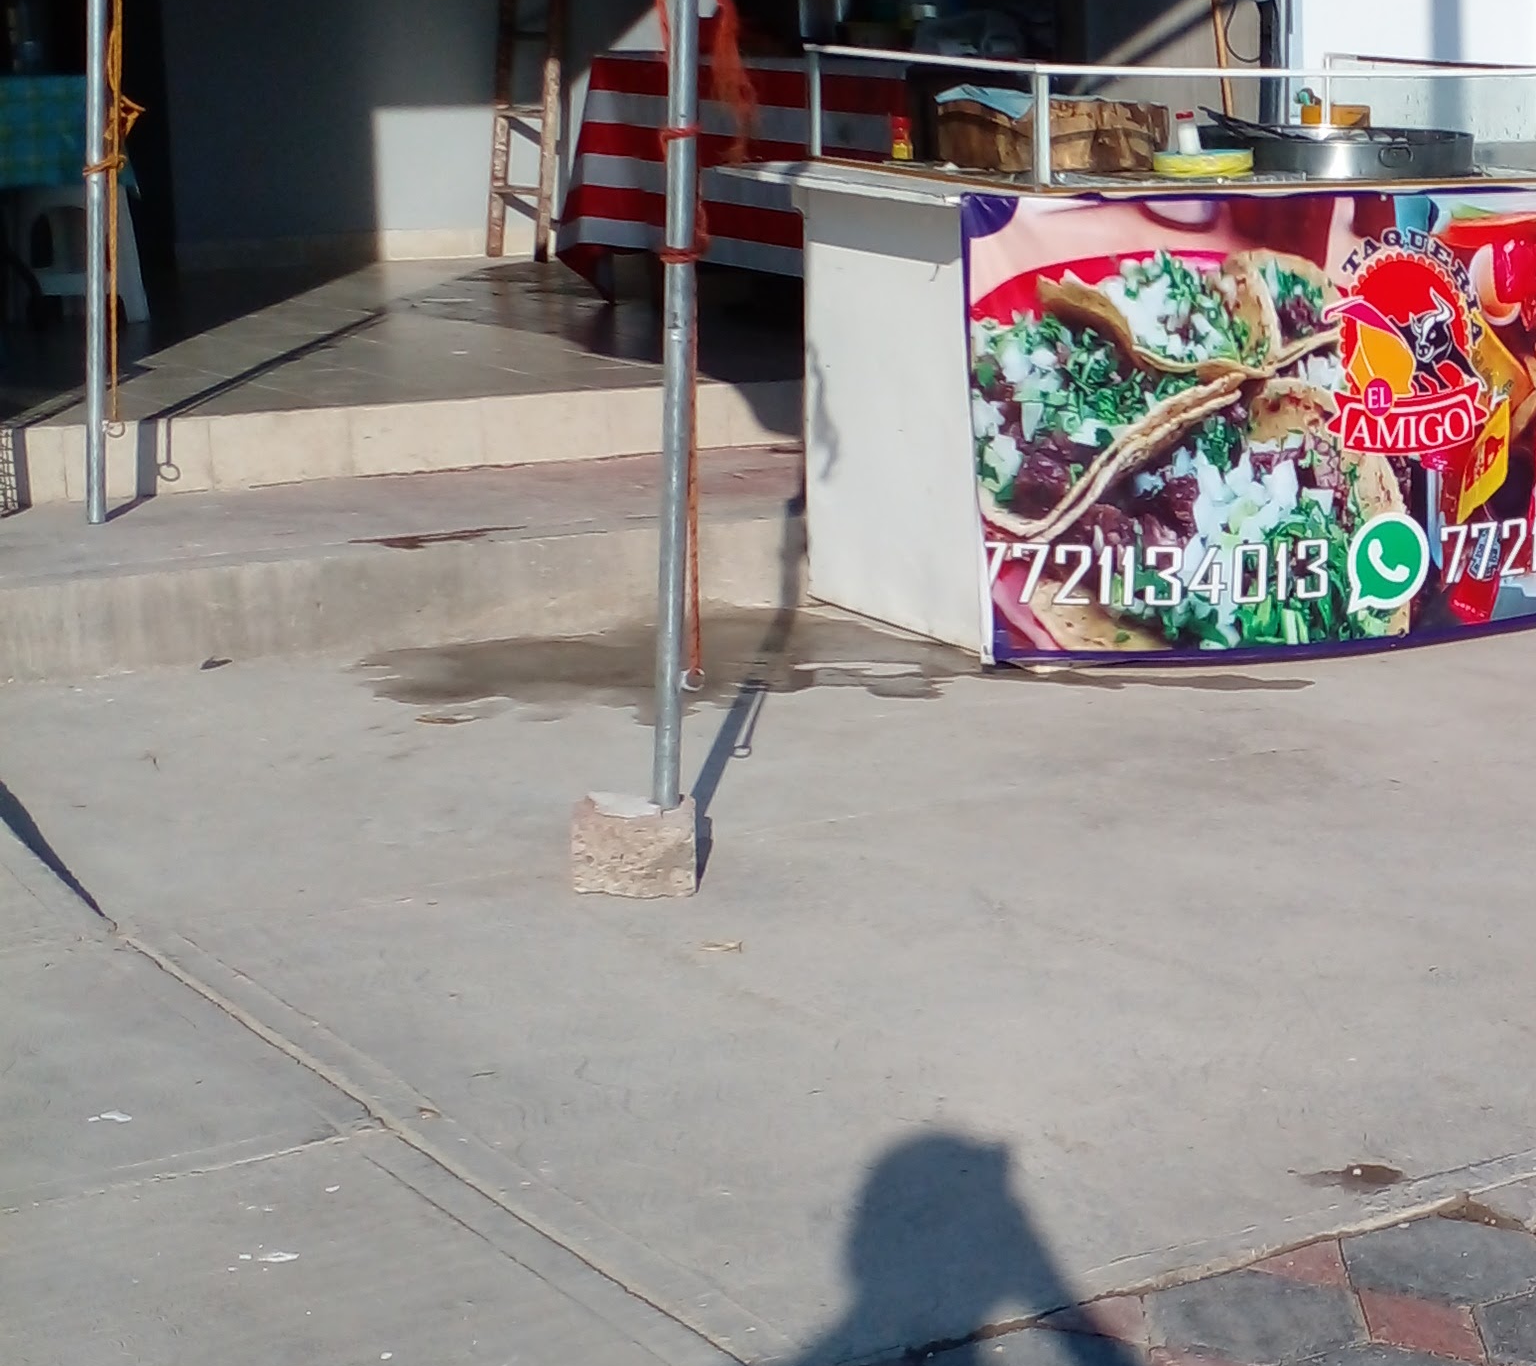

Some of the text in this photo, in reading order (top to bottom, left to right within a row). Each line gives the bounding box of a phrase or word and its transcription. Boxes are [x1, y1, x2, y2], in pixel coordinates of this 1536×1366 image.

[1367, 387, 1391, 409] EL
[1347, 407, 1470, 450] AMIGO
[985, 538, 1329, 606] 7721134013
